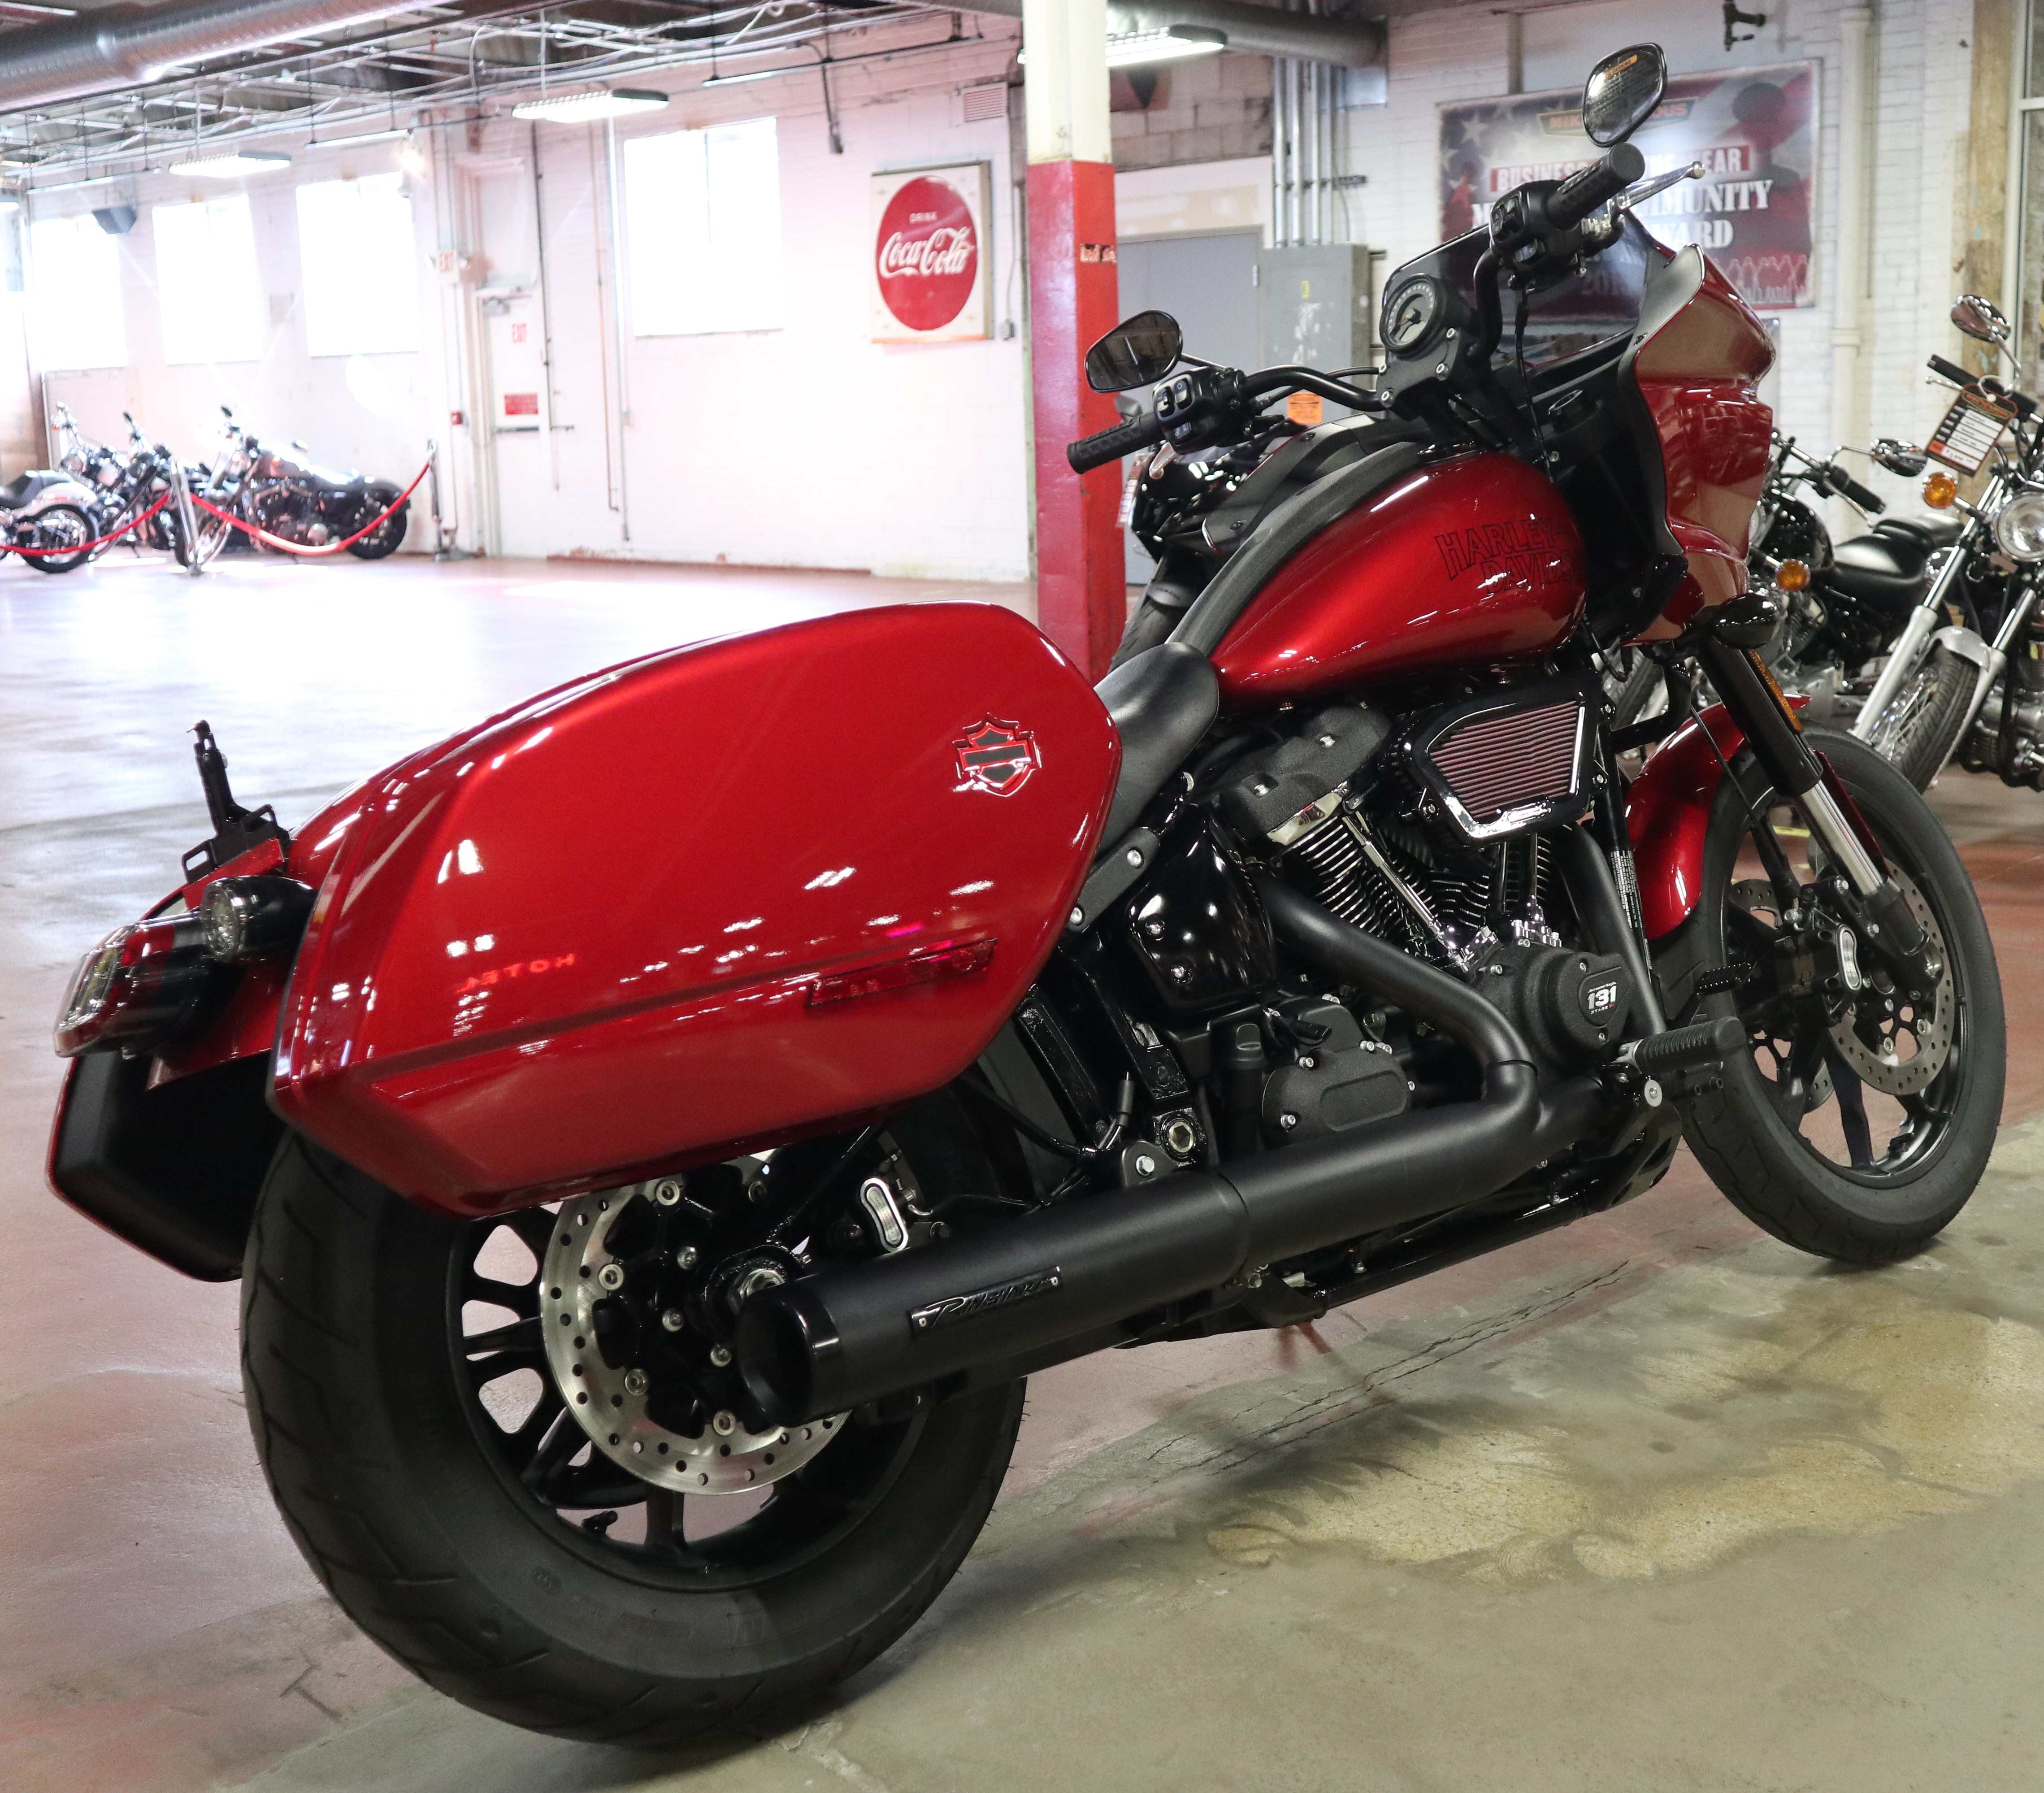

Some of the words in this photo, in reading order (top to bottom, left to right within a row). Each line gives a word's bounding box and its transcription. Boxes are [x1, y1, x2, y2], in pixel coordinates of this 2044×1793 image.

[1701, 146, 1742, 173] EAR
[1587, 985, 1617, 1010] 131
[1590, 1005, 1608, 1015] STAGE
